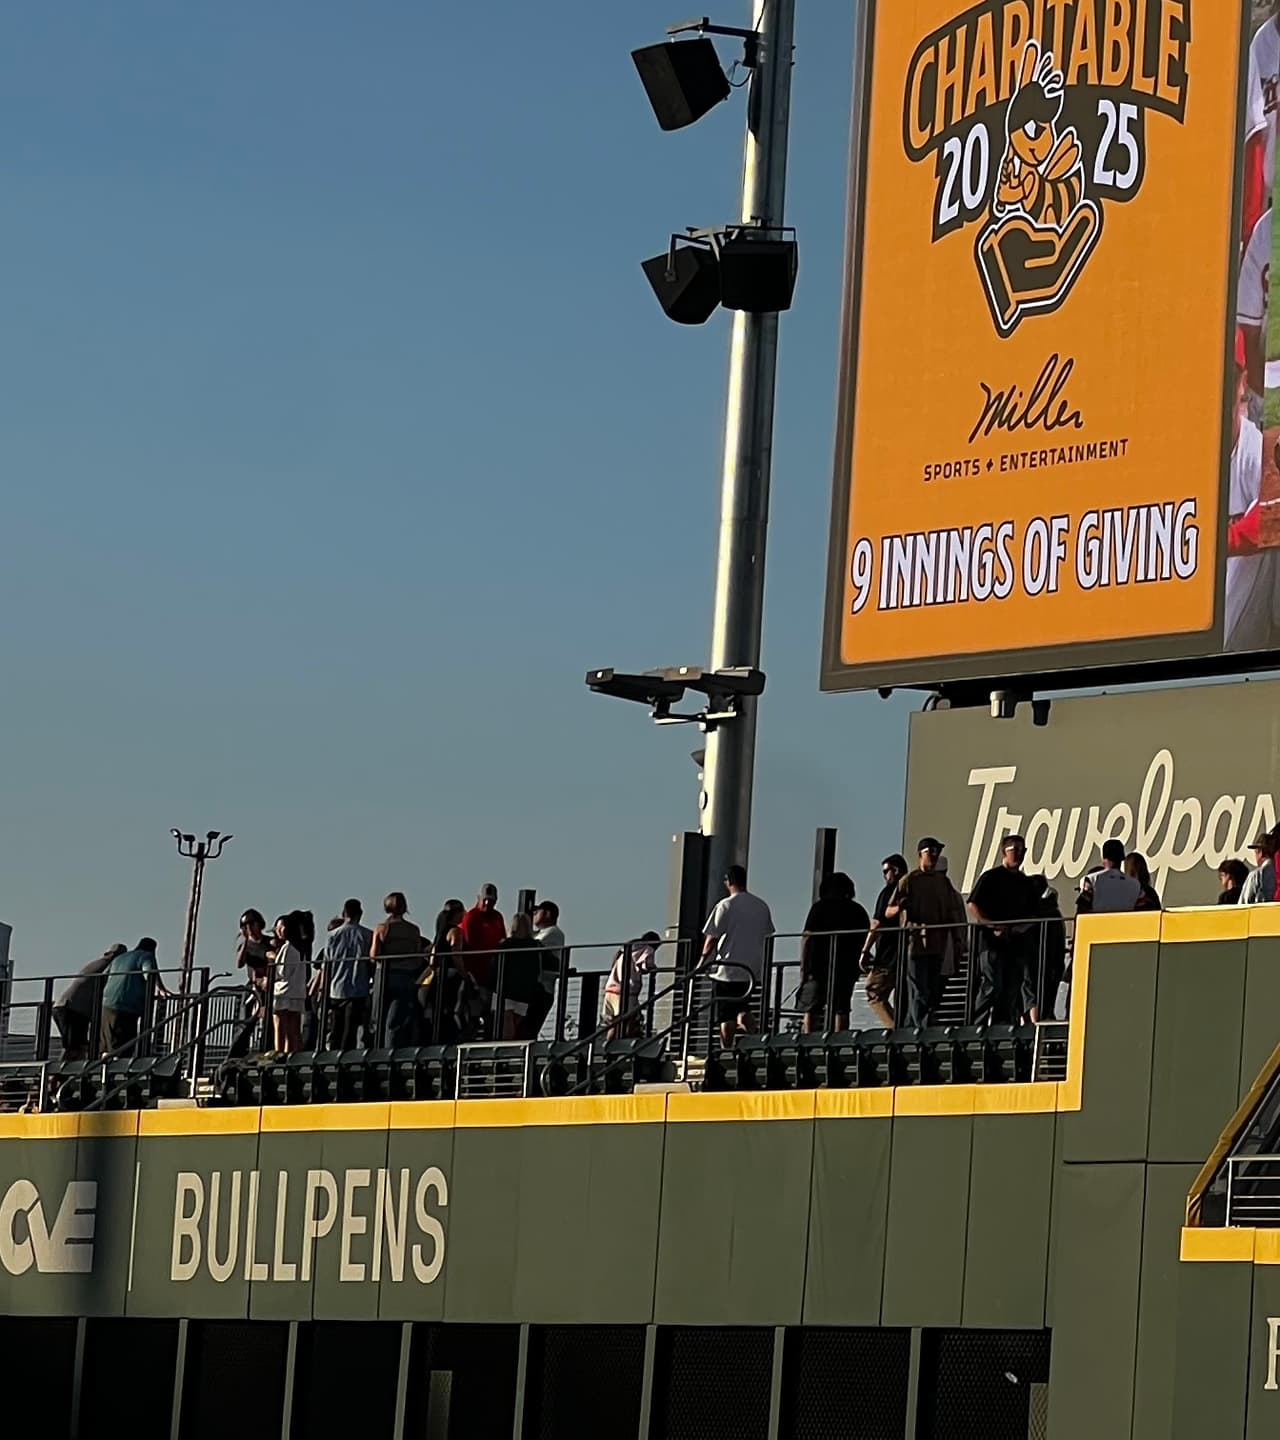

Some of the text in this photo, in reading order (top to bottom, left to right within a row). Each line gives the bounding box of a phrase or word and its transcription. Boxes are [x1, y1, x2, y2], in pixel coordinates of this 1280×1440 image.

[938, 98, 1139, 226] 20 25
[967, 352, 1084, 445] Miller
[923, 457, 982, 483] SPORTS
[999, 438, 1130, 474] ENTERTAINMENT
[850, 496, 1199, 617] 9 INNINGS OF GIVING
[170, 1166, 450, 1286] BULLPENS
